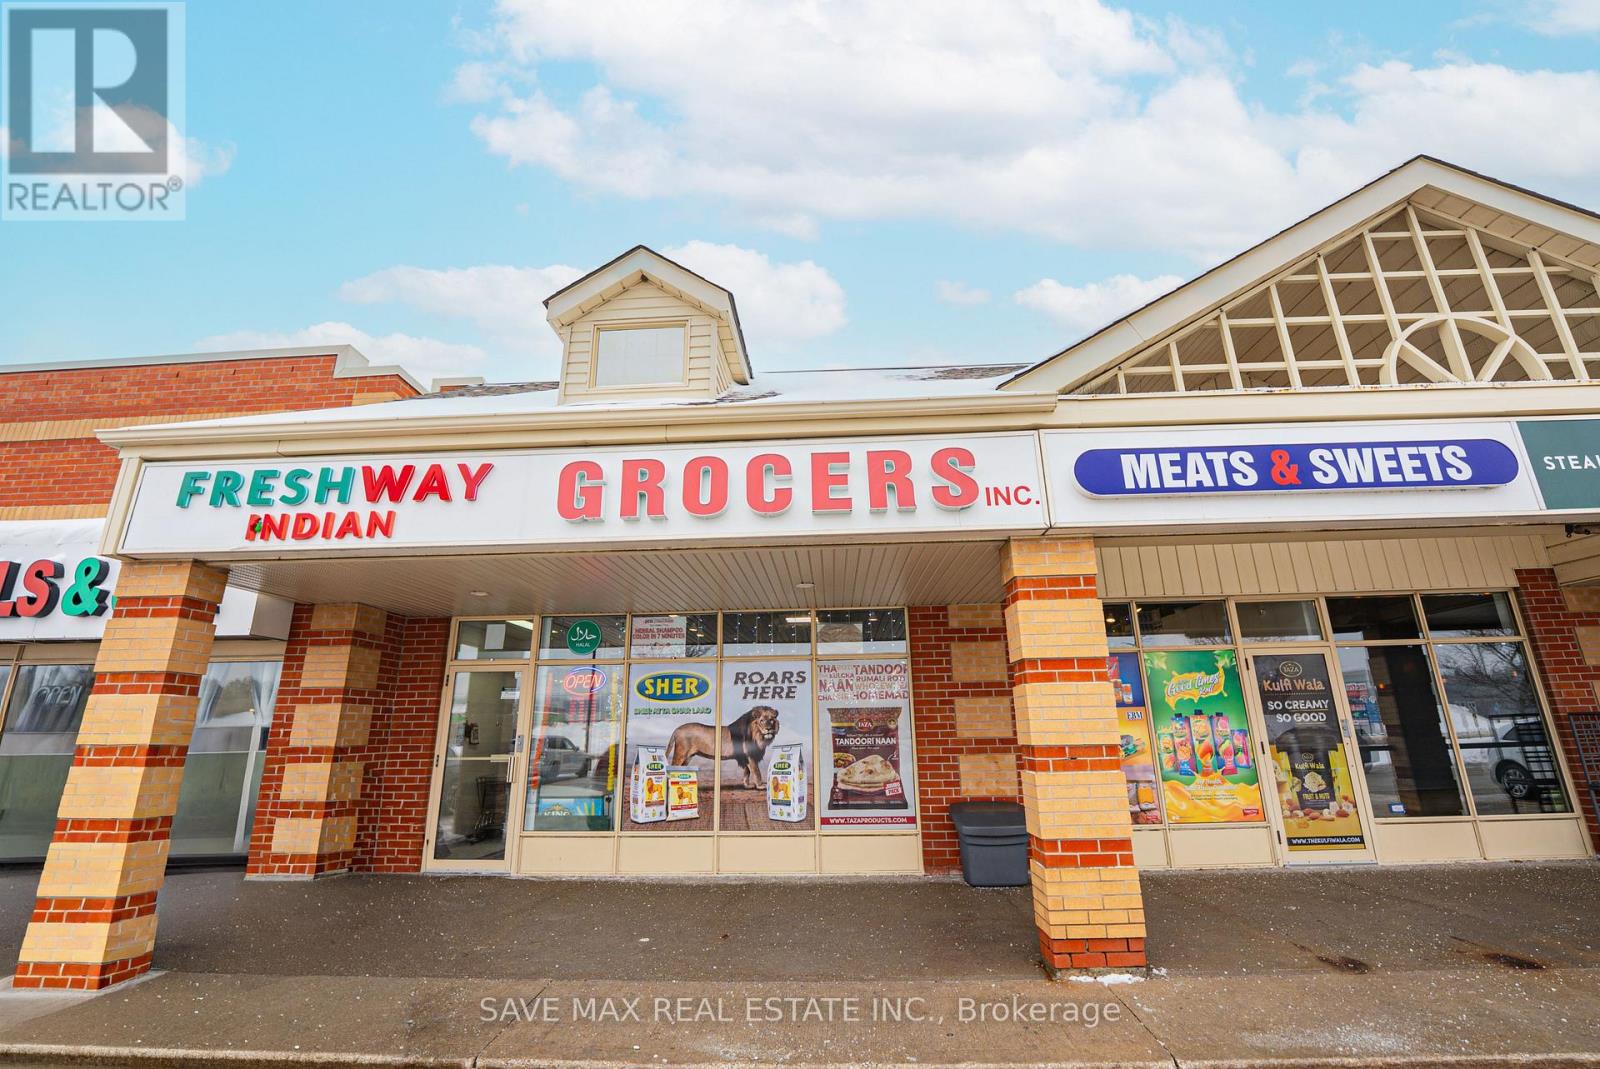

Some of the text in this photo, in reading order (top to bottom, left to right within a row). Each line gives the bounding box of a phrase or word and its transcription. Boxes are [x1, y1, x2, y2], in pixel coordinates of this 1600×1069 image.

[1119, 445, 1473, 489] MEATS & SWEETS
[557, 447, 980, 522] GROCERS
[985, 485, 1040, 507] INC.
[244, 510, 396, 541] INDIAN
[571, 627, 597, 641] حلال
[566, 674, 603, 688] OPEN
[734, 670, 808, 686] ROARS
[1263, 678, 1325, 692] Kulfi Wala
[645, 677, 699, 696] SHER
[742, 686, 797, 700] HERE
[33, 686, 83, 705] OPEN
[1267, 699, 1329, 711] SO CREAMY
[1276, 712, 1327, 723] SO GOOD
[834, 737, 897, 745] TANDOORI NAAN
